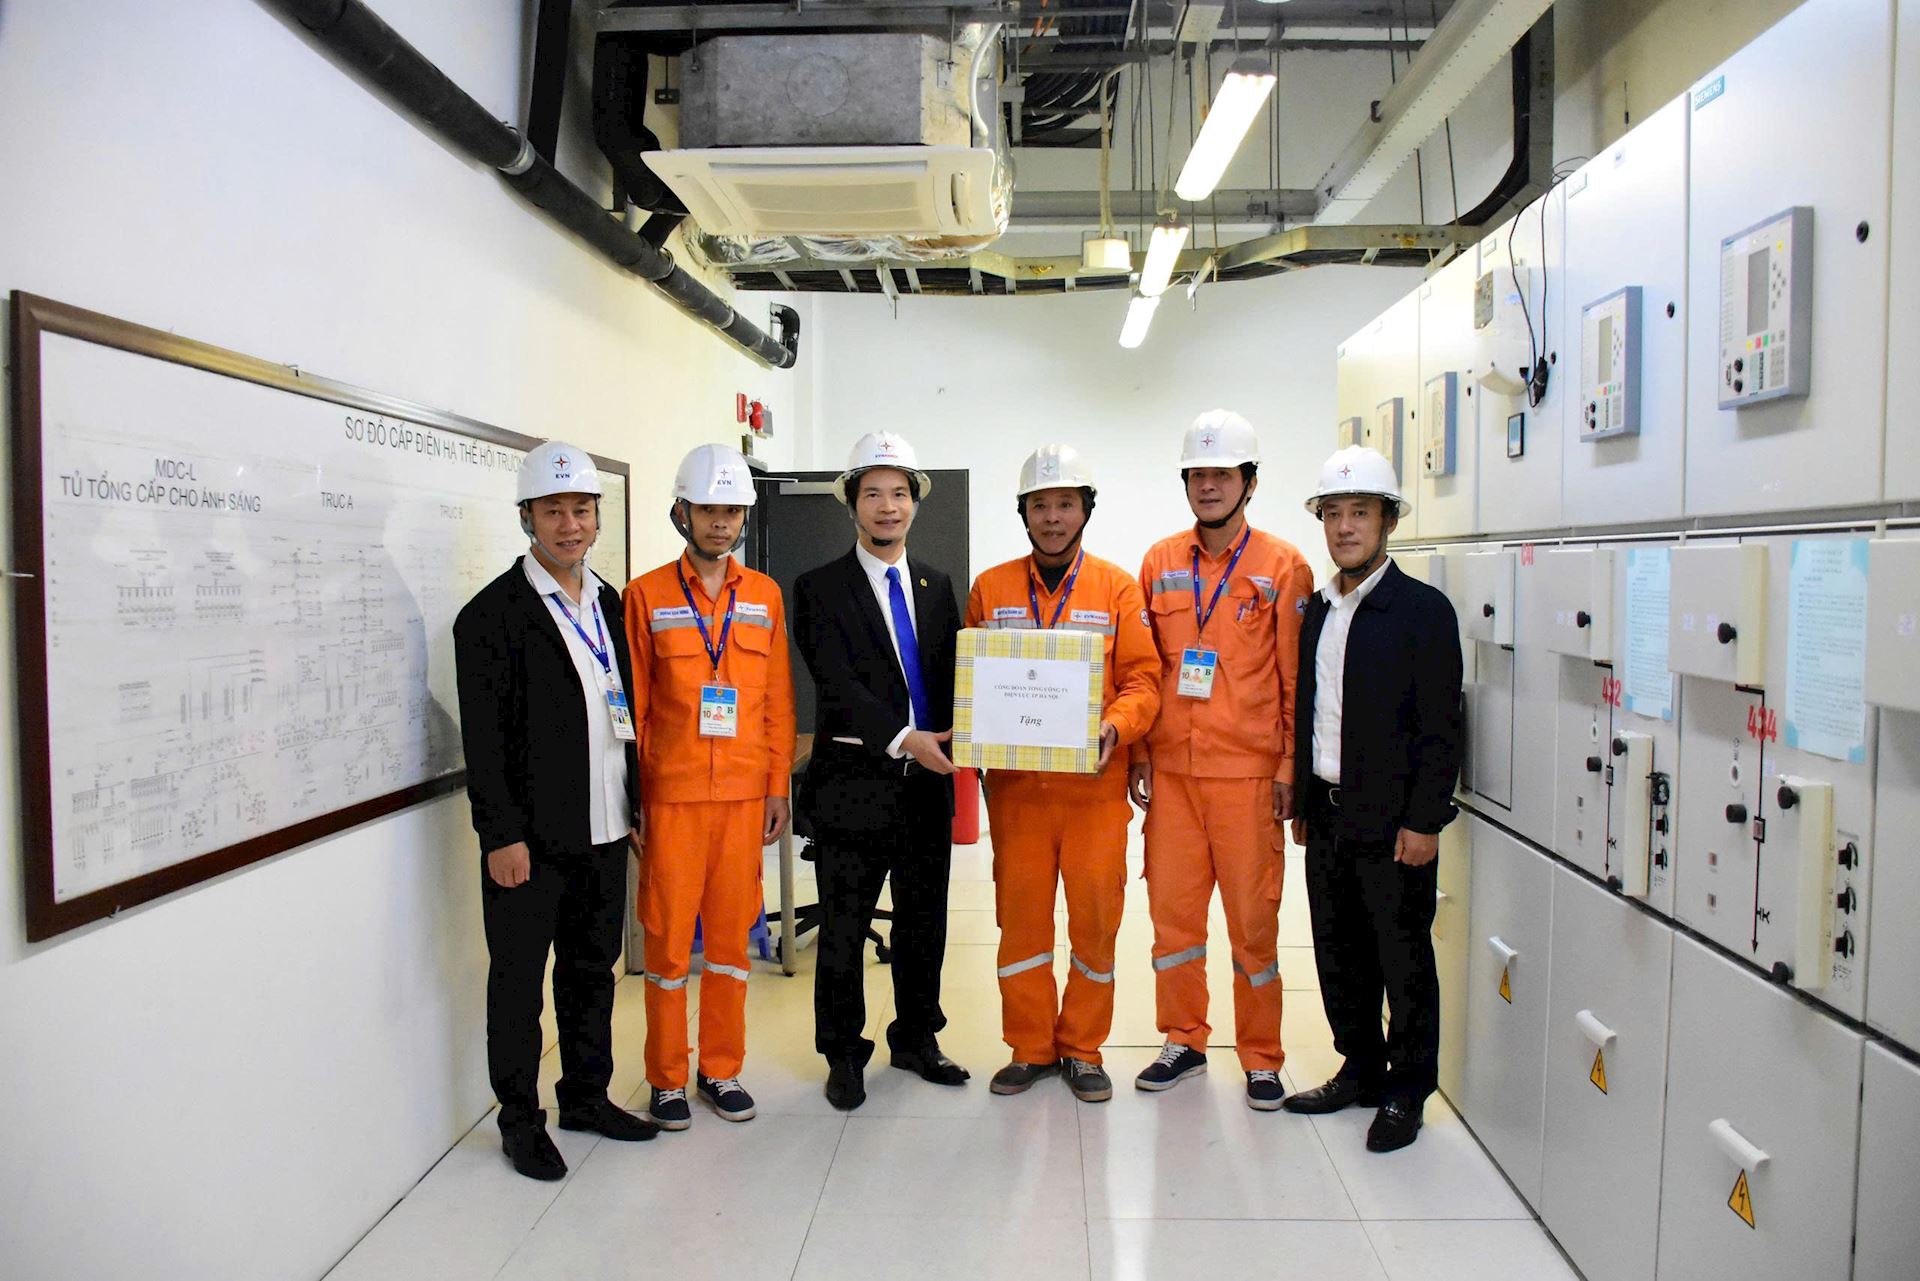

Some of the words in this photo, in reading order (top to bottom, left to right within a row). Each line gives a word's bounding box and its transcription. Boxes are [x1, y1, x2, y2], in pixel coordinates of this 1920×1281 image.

[344, 416, 364, 441] SƠ
[367, 416, 387, 446] ĐỒ
[389, 422, 413, 450] CẤP
[416, 431, 441, 460] ĐIỆN
[155, 458, 197, 481] MDC-L
[60, 470, 83, 497] TỦ
[87, 470, 132, 502] TỔNG
[136, 478, 165, 504] CẤP
[169, 486, 199, 508] CHO
[229, 489, 262, 513] SÁNG
[347, 495, 354, 510] A
[1020, 715, 1042, 727] Tặng
[1747, 704, 1777, 744] 434
